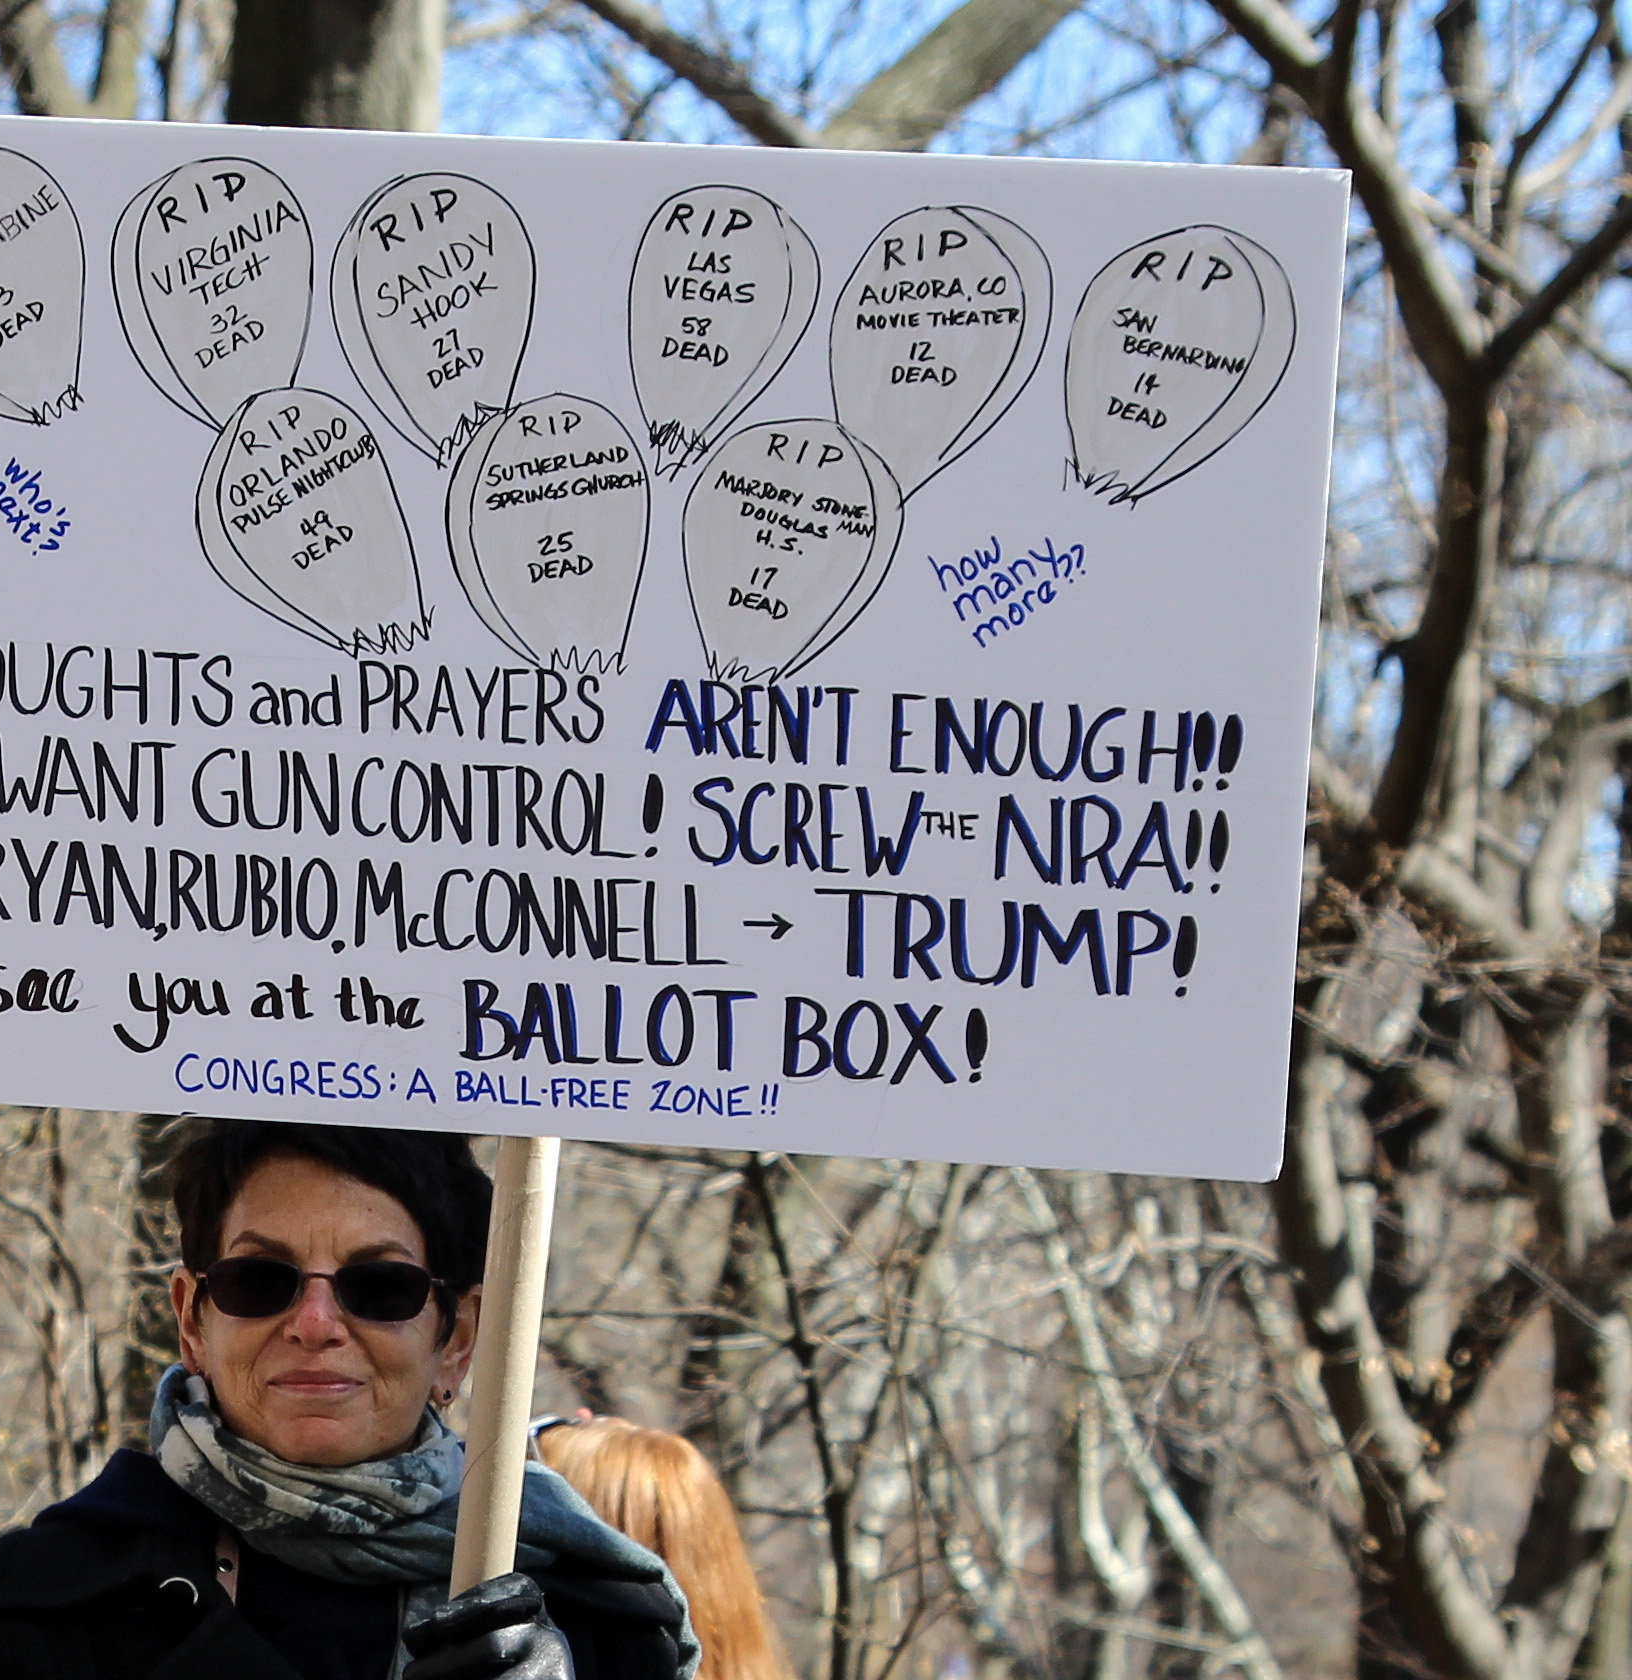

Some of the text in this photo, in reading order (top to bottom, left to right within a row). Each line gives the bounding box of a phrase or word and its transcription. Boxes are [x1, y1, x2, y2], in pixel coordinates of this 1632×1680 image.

[157, 172, 246, 232] RIP
[370, 190, 457, 250] RIP
[665, 204, 752, 237] RIP
[151, 200, 301, 295] VIRGINIA
[687, 252, 731, 274] LAS
[882, 230, 968, 271] RIP
[190, 253, 270, 305] TECH
[377, 222, 495, 317] SANDY
[977, 276, 1006, 295] CO
[1131, 251, 1233, 290] RIP
[411, 272, 497, 328] HOOK
[664, 275, 756, 303] VEGAS
[210, 305, 248, 334] 32
[682, 317, 710, 337] 58
[857, 308, 1020, 329] MOVIE THEATER
[1112, 308, 1158, 334] SAN
[195, 320, 264, 368] DEAD
[433, 329, 459, 358] 27
[662, 338, 728, 366] DEAD
[910, 341, 935, 361] 12
[427, 347, 484, 388] DEAD
[891, 365, 957, 386] DEAD
[1135, 372, 1160, 395] 14
[240, 406, 300, 455] RIP
[519, 411, 581, 436] RIP
[1108, 396, 1167, 429] DEAD
[230, 418, 346, 506] ORLANDO
[485, 446, 629, 486] SUTHERLAND
[768, 433, 843, 468] RIP
[5, 457, 70, 536] who's
[231, 434, 375, 533] PULSE NIGHTCLUB
[485, 471, 645, 510] SPRINGS CHURCH
[715, 470, 804, 506] MARJORY
[300, 510, 333, 536] 49
[740, 502, 874, 538] DOUGLAS MAN
[292, 526, 353, 569] DEAD
[538, 531, 573, 556] 25
[528, 555, 593, 583] DEAD
[752, 568, 778, 587] 17
[927, 535, 1001, 592] how
[728, 587, 788, 619] DEAD
[250, 674, 341, 727] and
[360, 661, 604, 745] PRAYERS
[645, 679, 859, 766] AREN'T
[889, 693, 1243, 792] ENOUGH!!
[192, 748, 340, 835] GUN
[351, 757, 665, 859] CONTROL!
[688, 776, 924, 878] SCREW
[922, 811, 979, 841] THE
[994, 793, 1230, 895] NRA!!
[355, 858, 727, 966] McCONNELL
[814, 887, 1200, 999] TRUMP!
[113, 971, 230, 1053] you
[250, 973, 310, 1020] at
[334, 976, 425, 1030] the
[459, 978, 758, 1072] BALLOT
[782, 997, 990, 1087] BOX!
[174, 1053, 781, 1117] CONGRESS: A BALL-FREE ZONE!!
